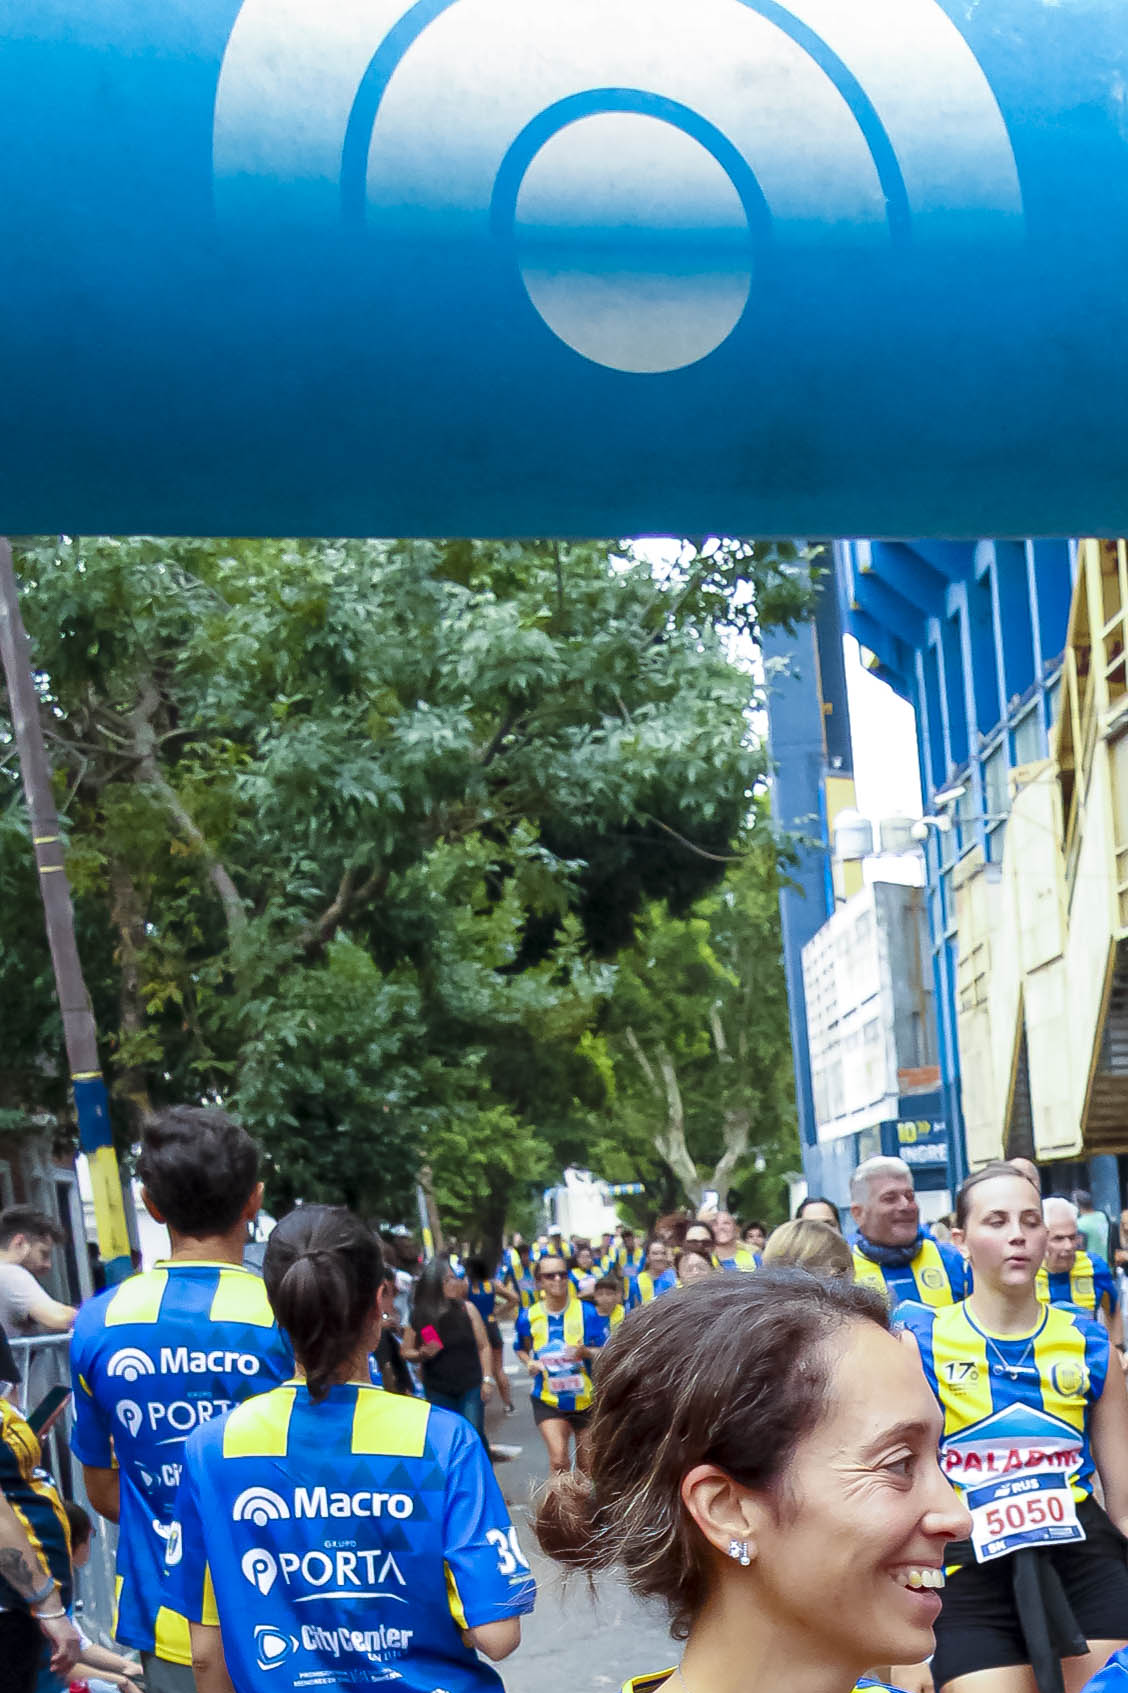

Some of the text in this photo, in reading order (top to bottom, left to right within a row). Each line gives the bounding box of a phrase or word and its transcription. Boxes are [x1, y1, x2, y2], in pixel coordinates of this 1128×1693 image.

[160, 1347, 260, 1375] Macro
[1012, 1477, 1040, 1494] RUS
[294, 1486, 414, 1519] Macro
[986, 1496, 1064, 1537] 5050
[279, 1550, 407, 1586] PORTA
[301, 1624, 414, 1658] CityCenter
